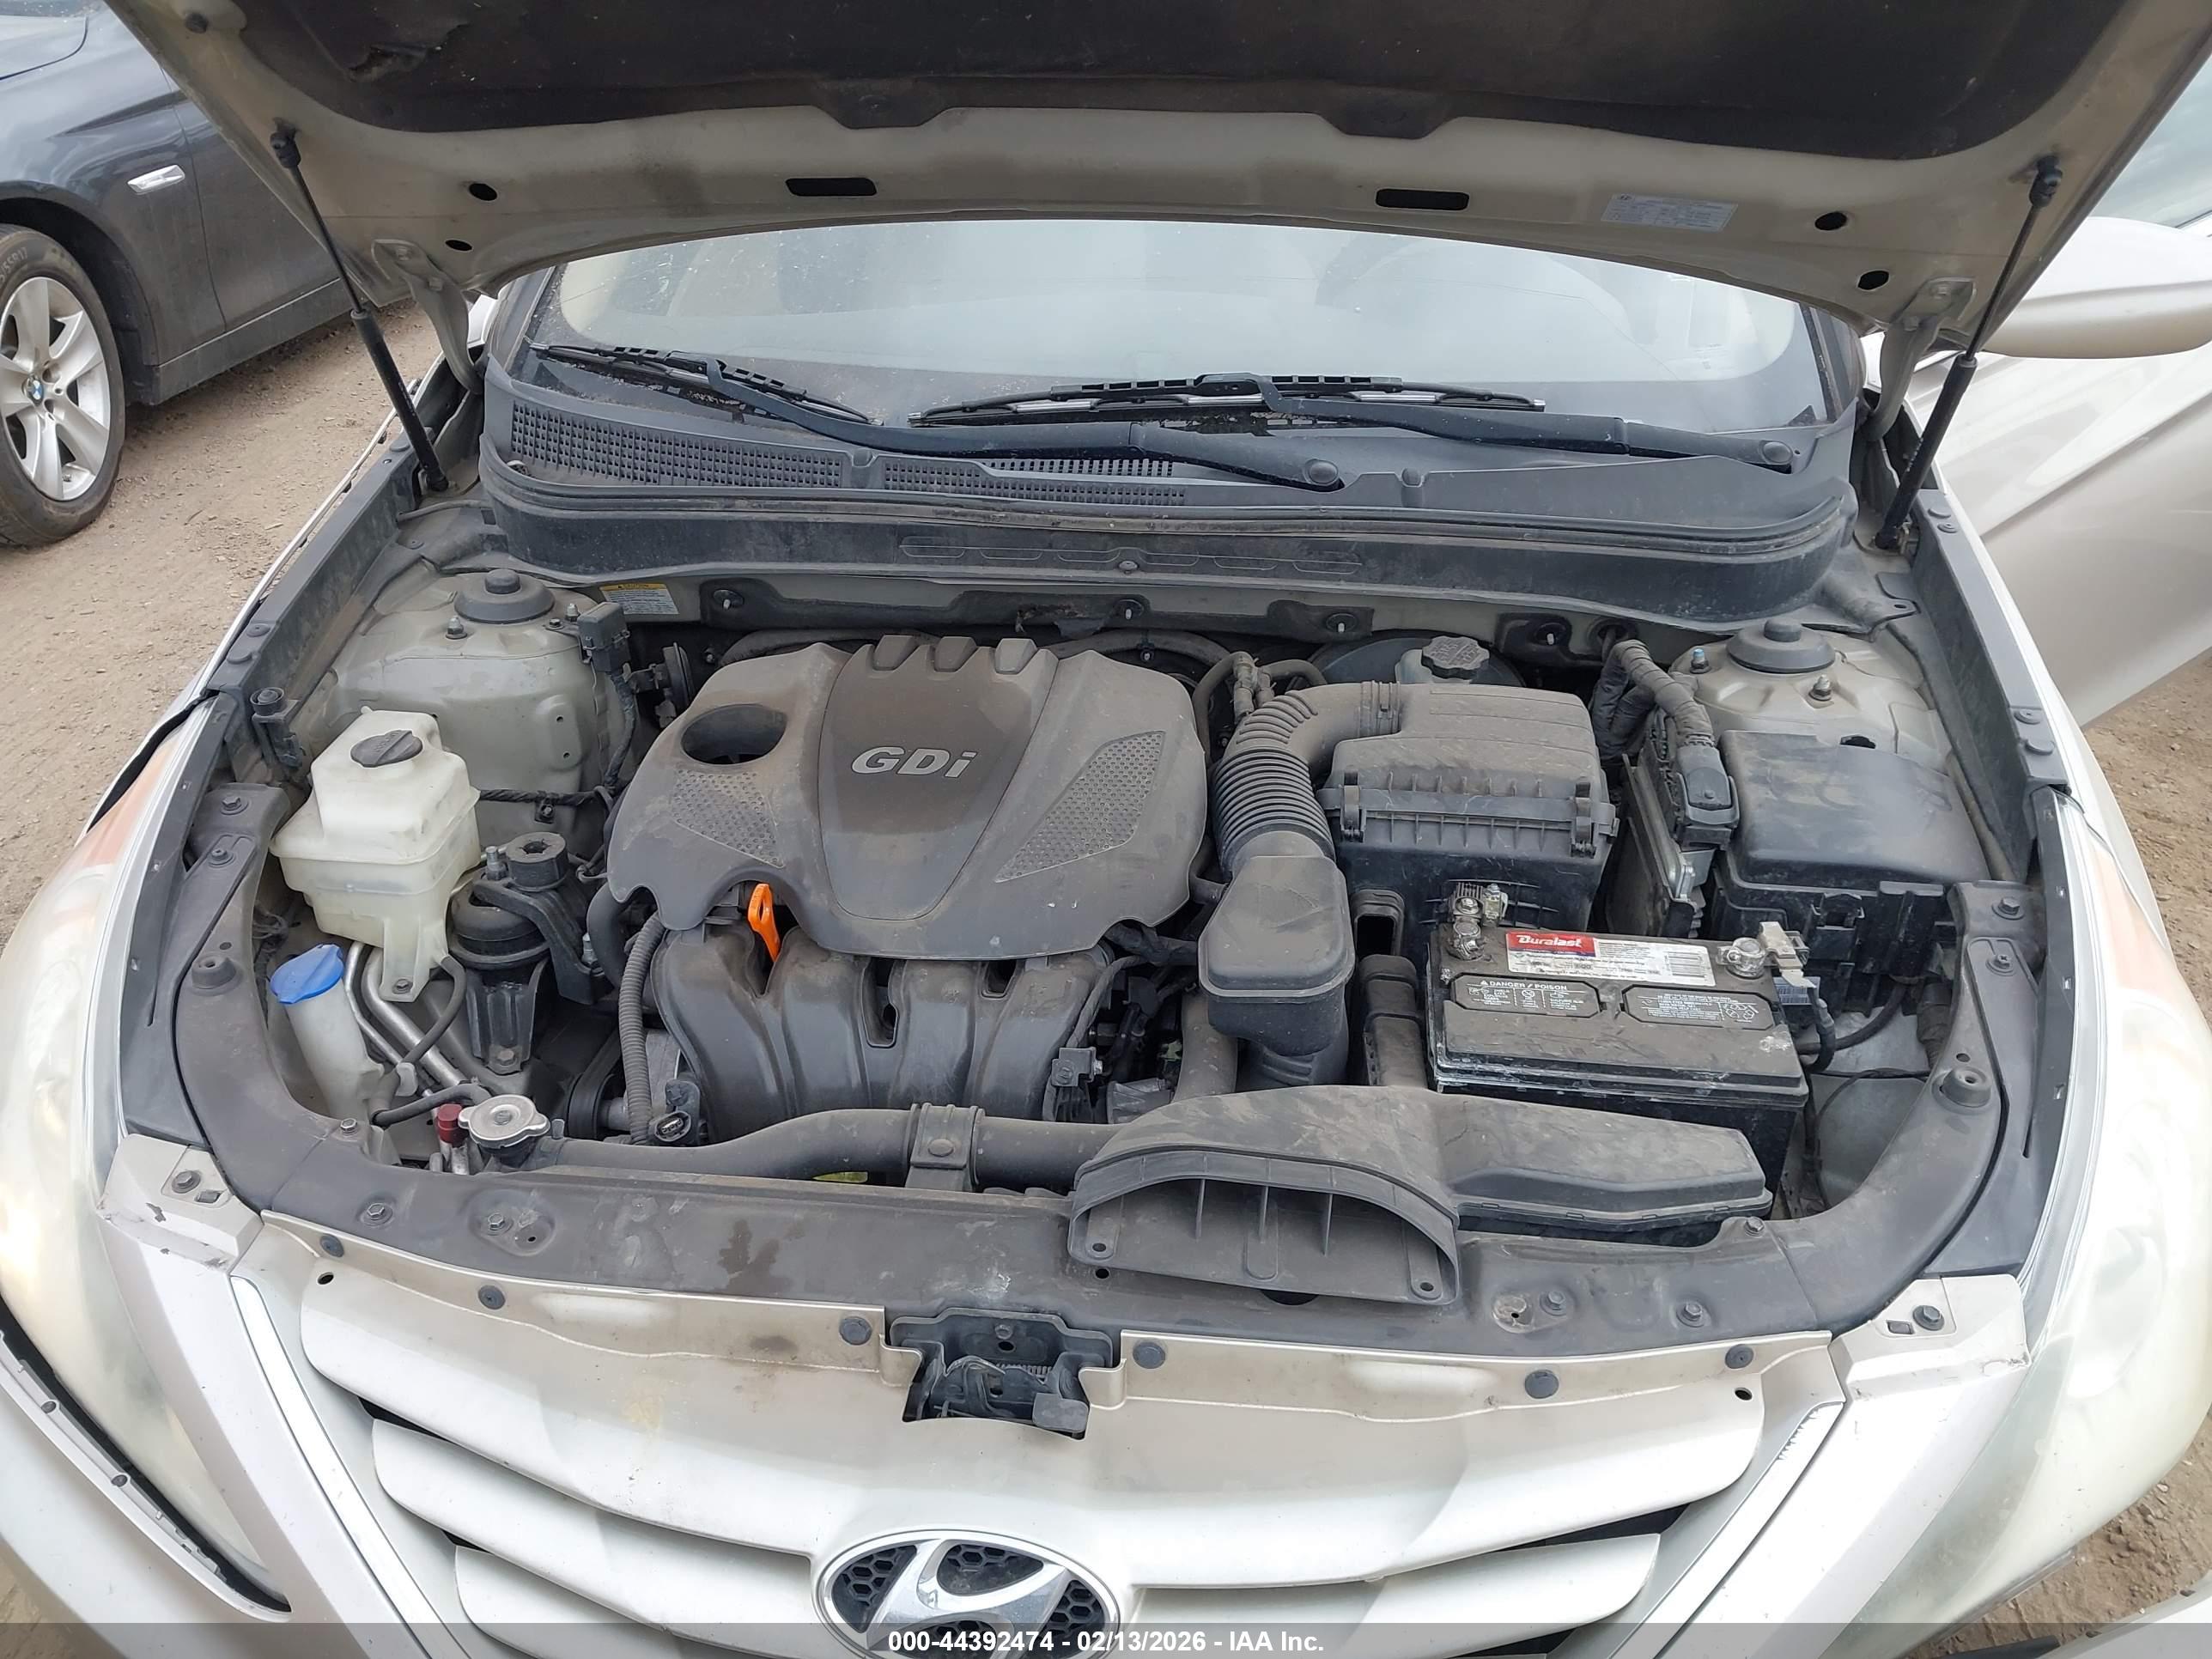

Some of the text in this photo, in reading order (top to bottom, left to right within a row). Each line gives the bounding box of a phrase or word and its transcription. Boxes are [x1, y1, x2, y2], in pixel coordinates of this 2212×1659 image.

[851, 745, 978, 779] GDi
[1516, 934, 1583, 948] Duralast
[1534, 982, 1568, 991] POISON
